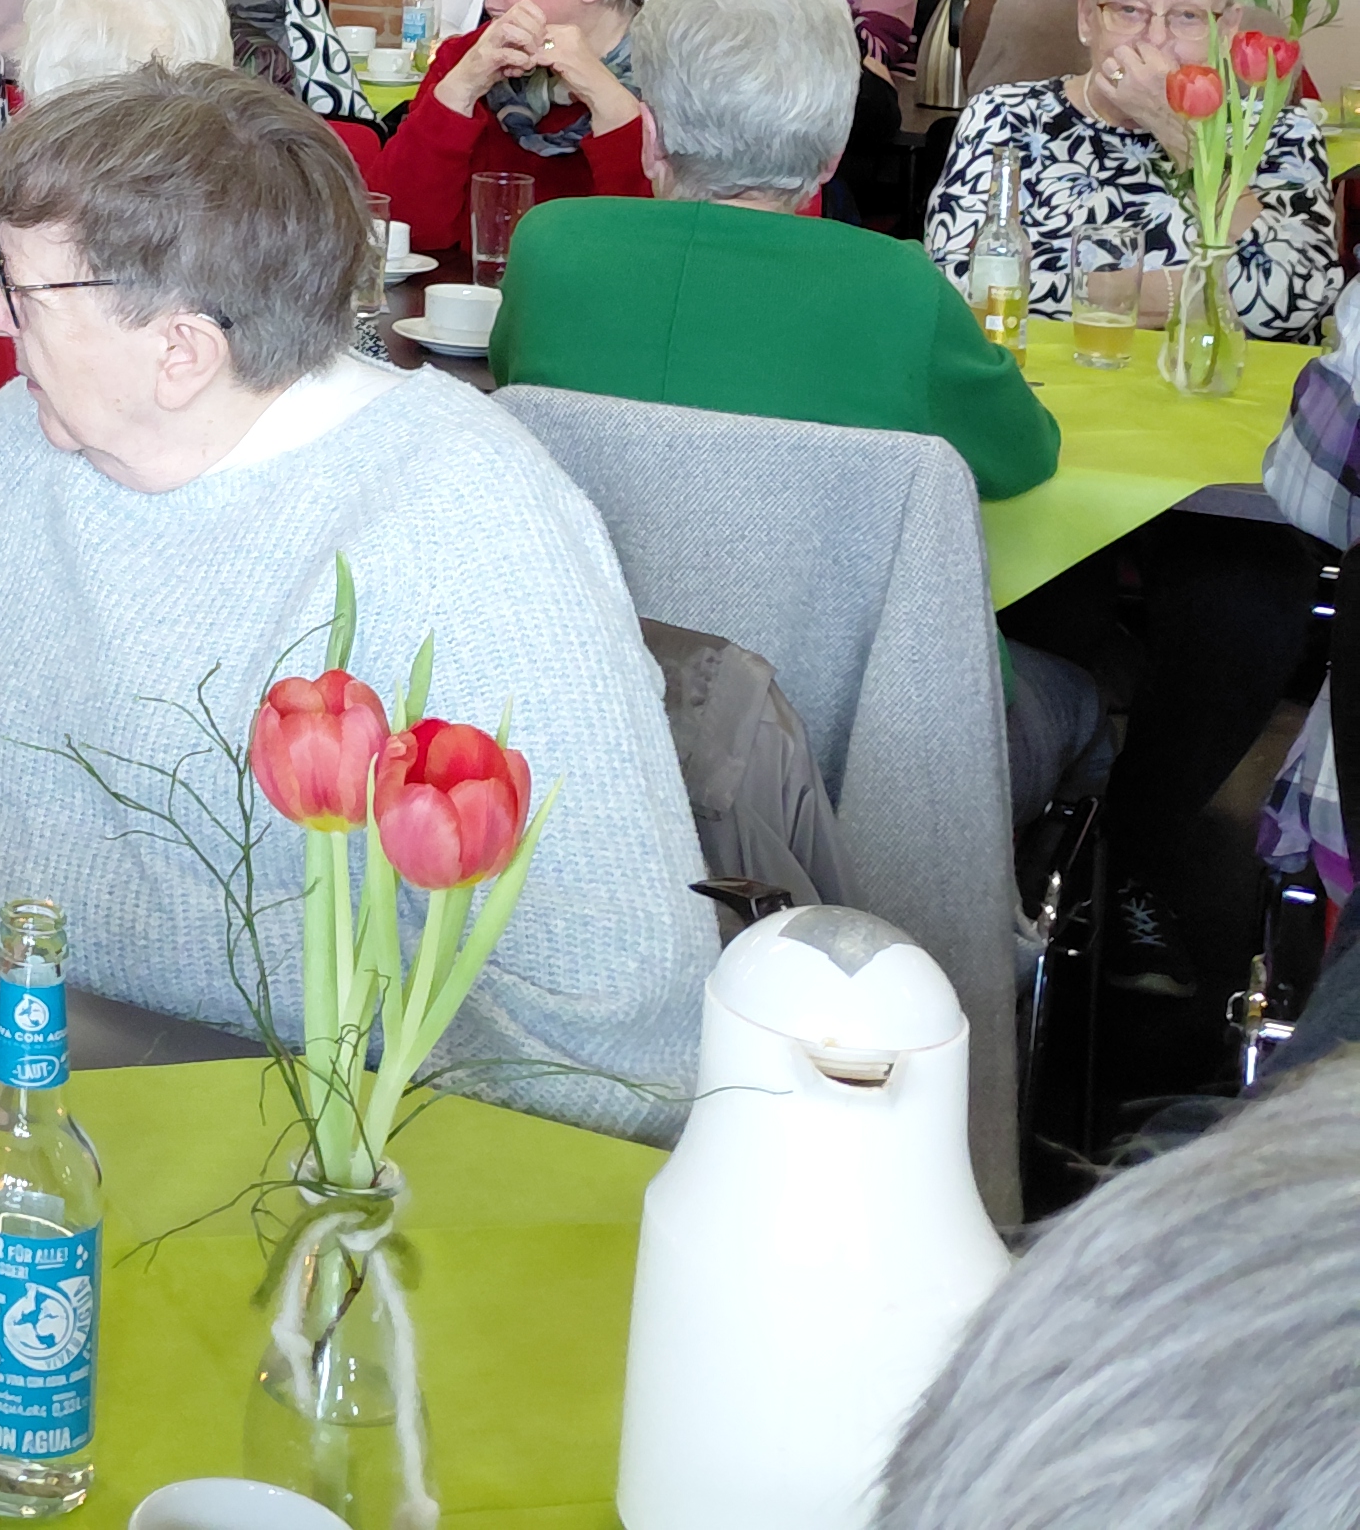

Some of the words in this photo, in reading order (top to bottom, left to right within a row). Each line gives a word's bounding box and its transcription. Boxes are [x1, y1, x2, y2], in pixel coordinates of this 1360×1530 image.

[14, 1031, 44, 1043] CON
[8, 1244, 32, 1263] FÜR
[35, 1247, 68, 1263] ALLE!
[21, 1427, 71, 1454] AGUA
